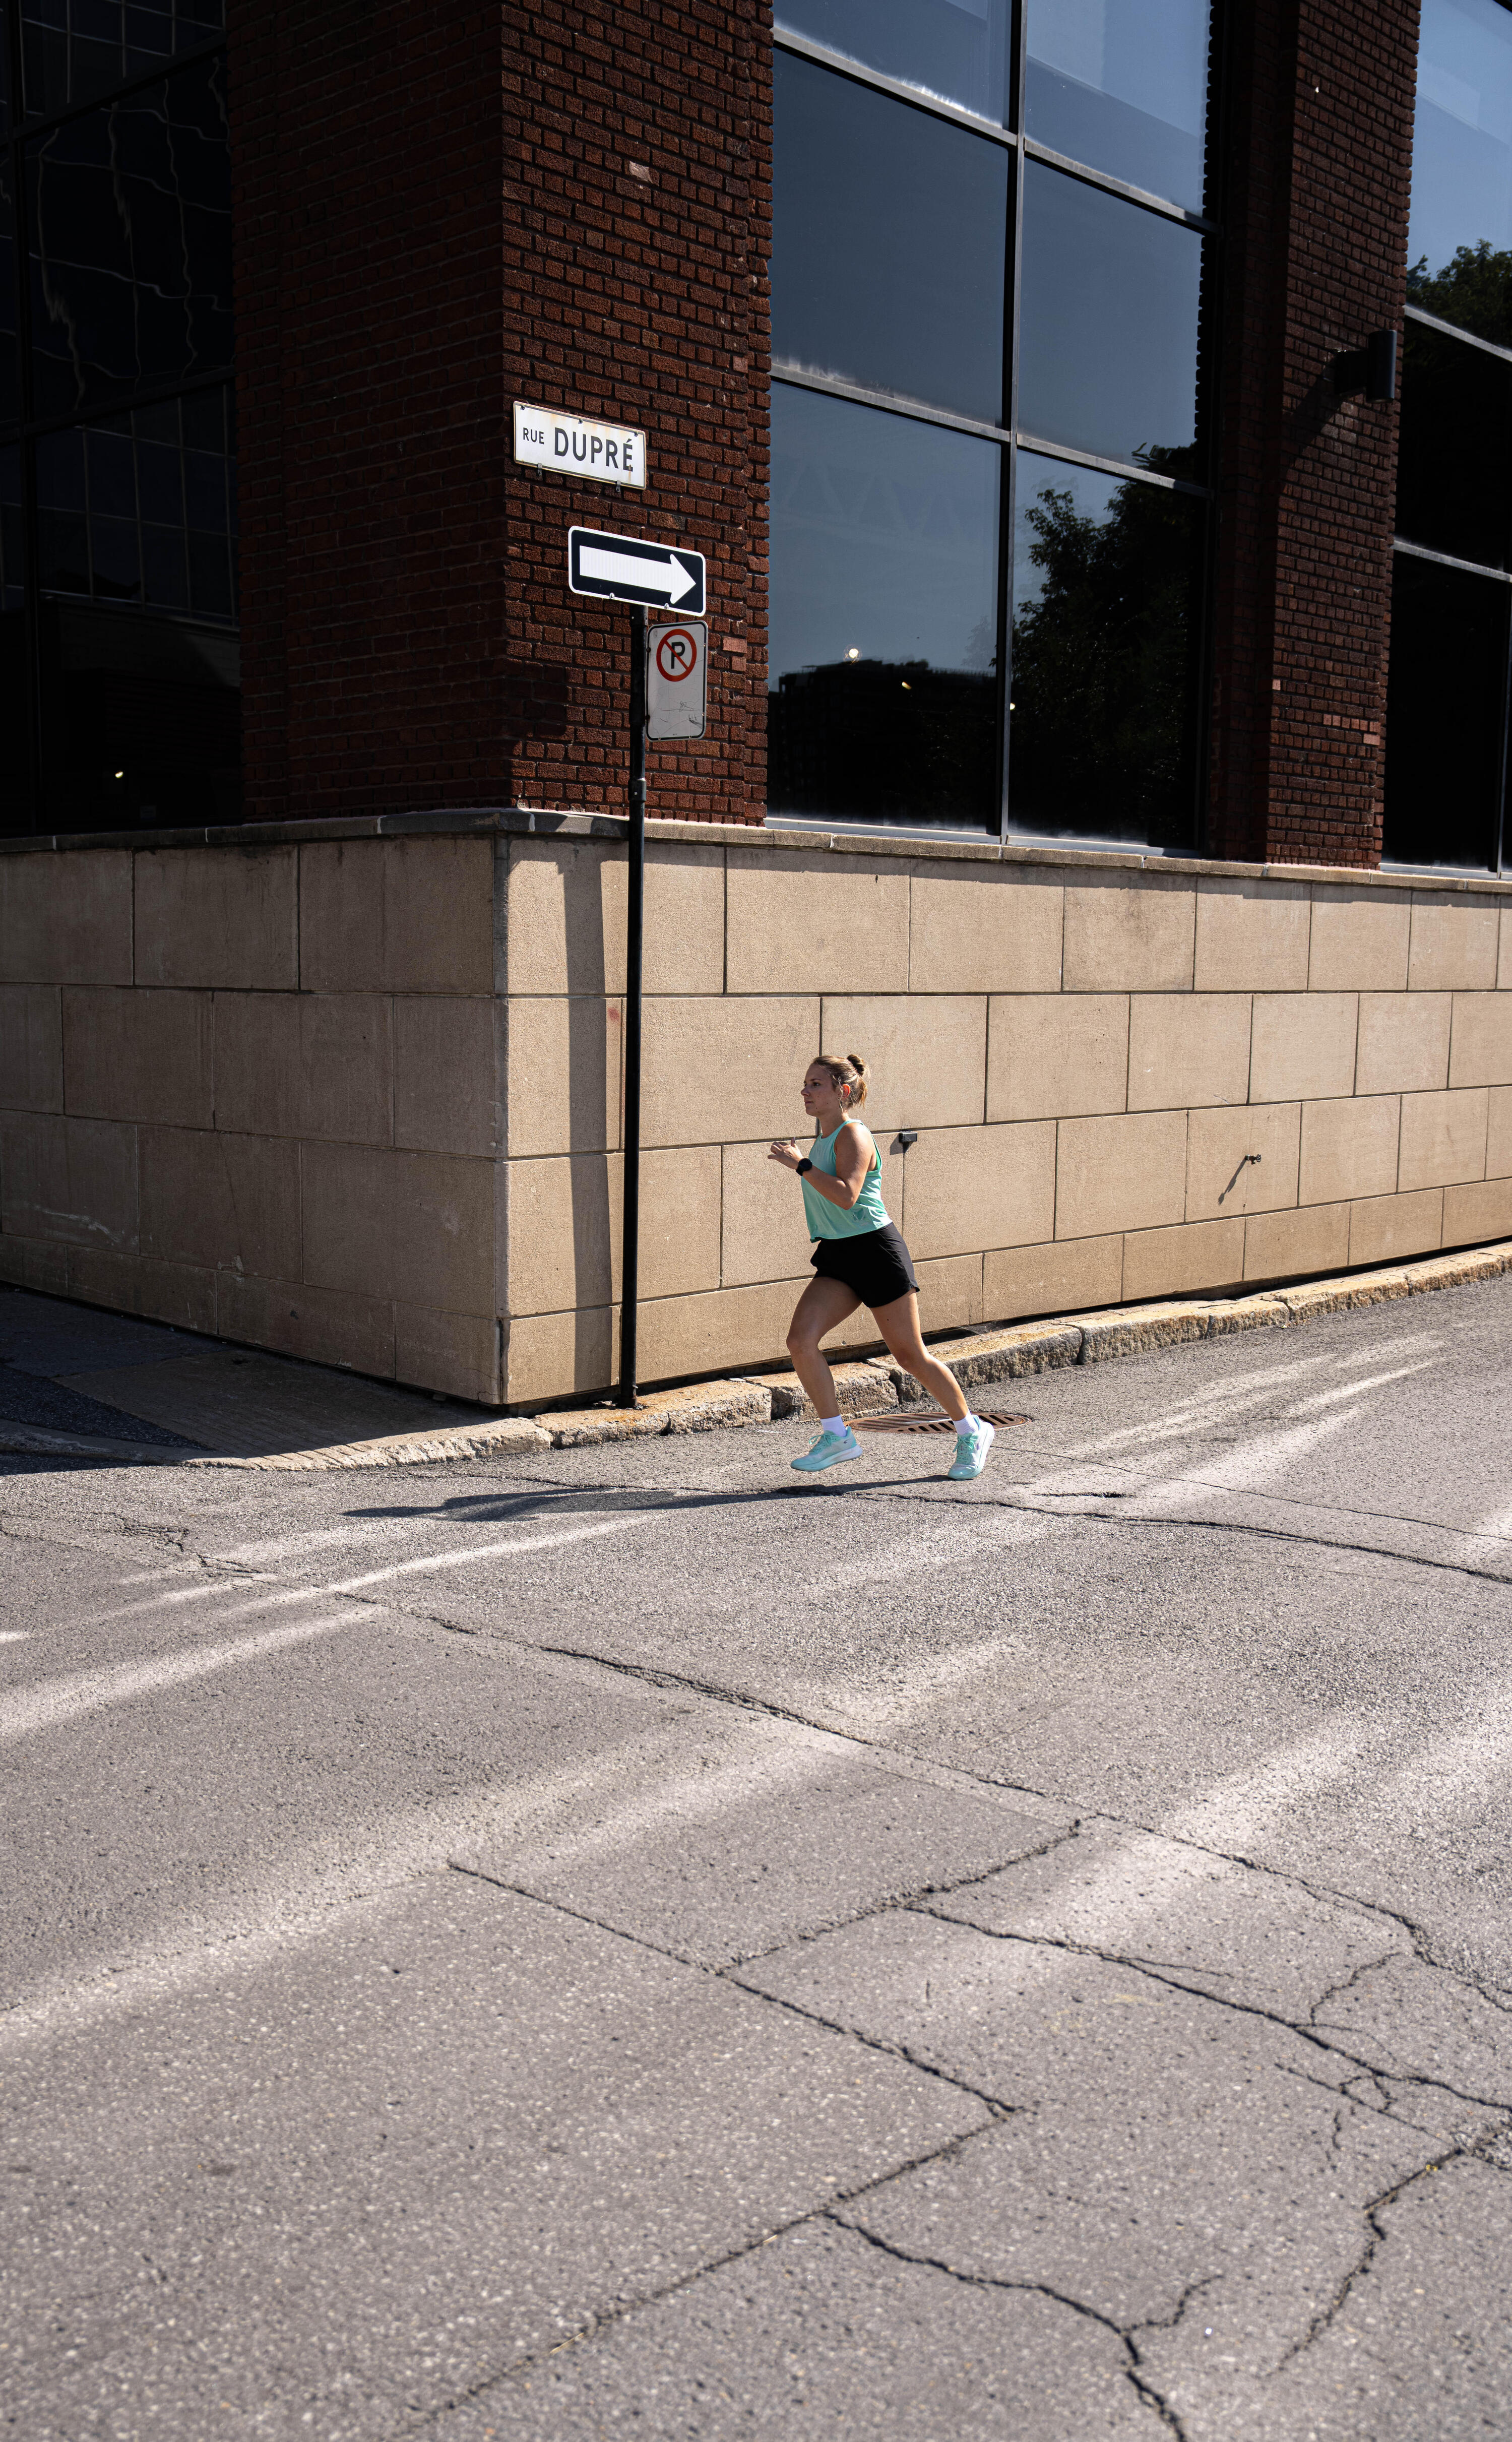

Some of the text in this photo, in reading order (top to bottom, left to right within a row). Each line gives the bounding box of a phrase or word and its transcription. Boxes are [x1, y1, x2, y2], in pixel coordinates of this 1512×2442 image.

[523, 427, 634, 472] RUE DUPRÉ
[671, 641, 685, 669] P
